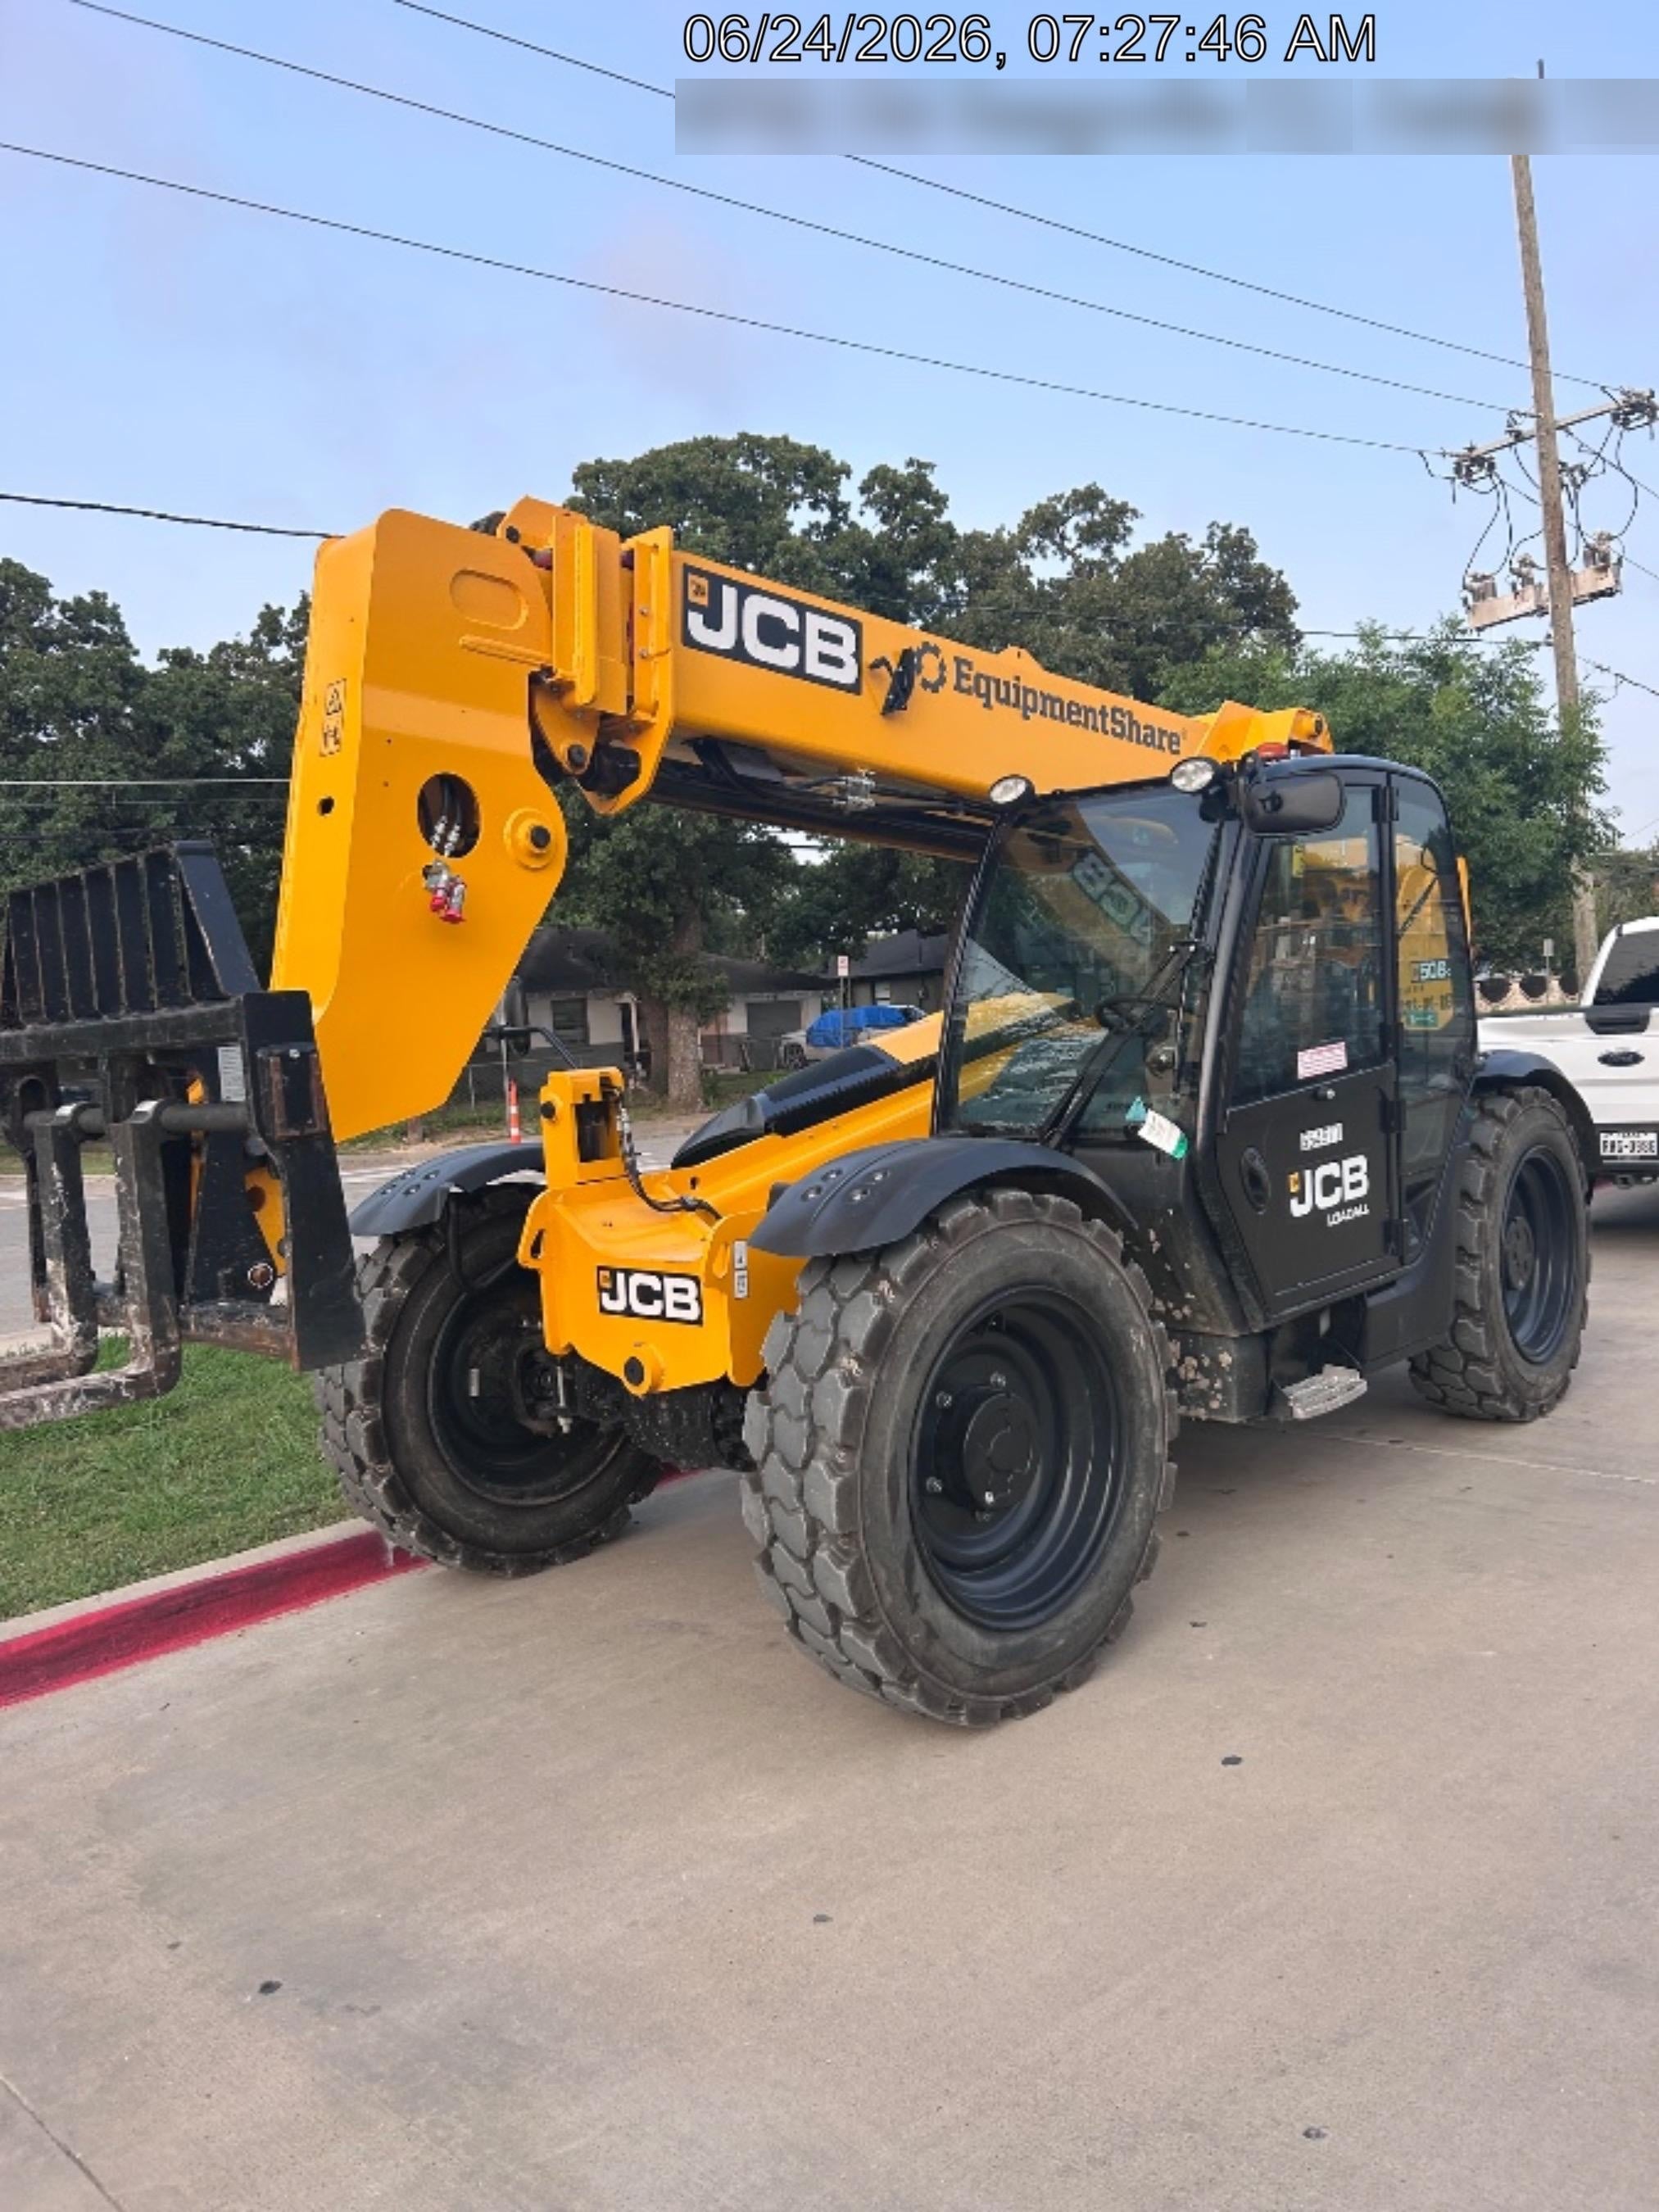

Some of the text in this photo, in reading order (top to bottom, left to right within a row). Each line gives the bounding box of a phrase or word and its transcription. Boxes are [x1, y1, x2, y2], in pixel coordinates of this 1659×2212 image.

[687, 584, 859, 685] JCB
[954, 655, 1181, 755] EquipmentShare
[1290, 1154, 1369, 1217] JCB
[601, 1271, 701, 1321] JCB
